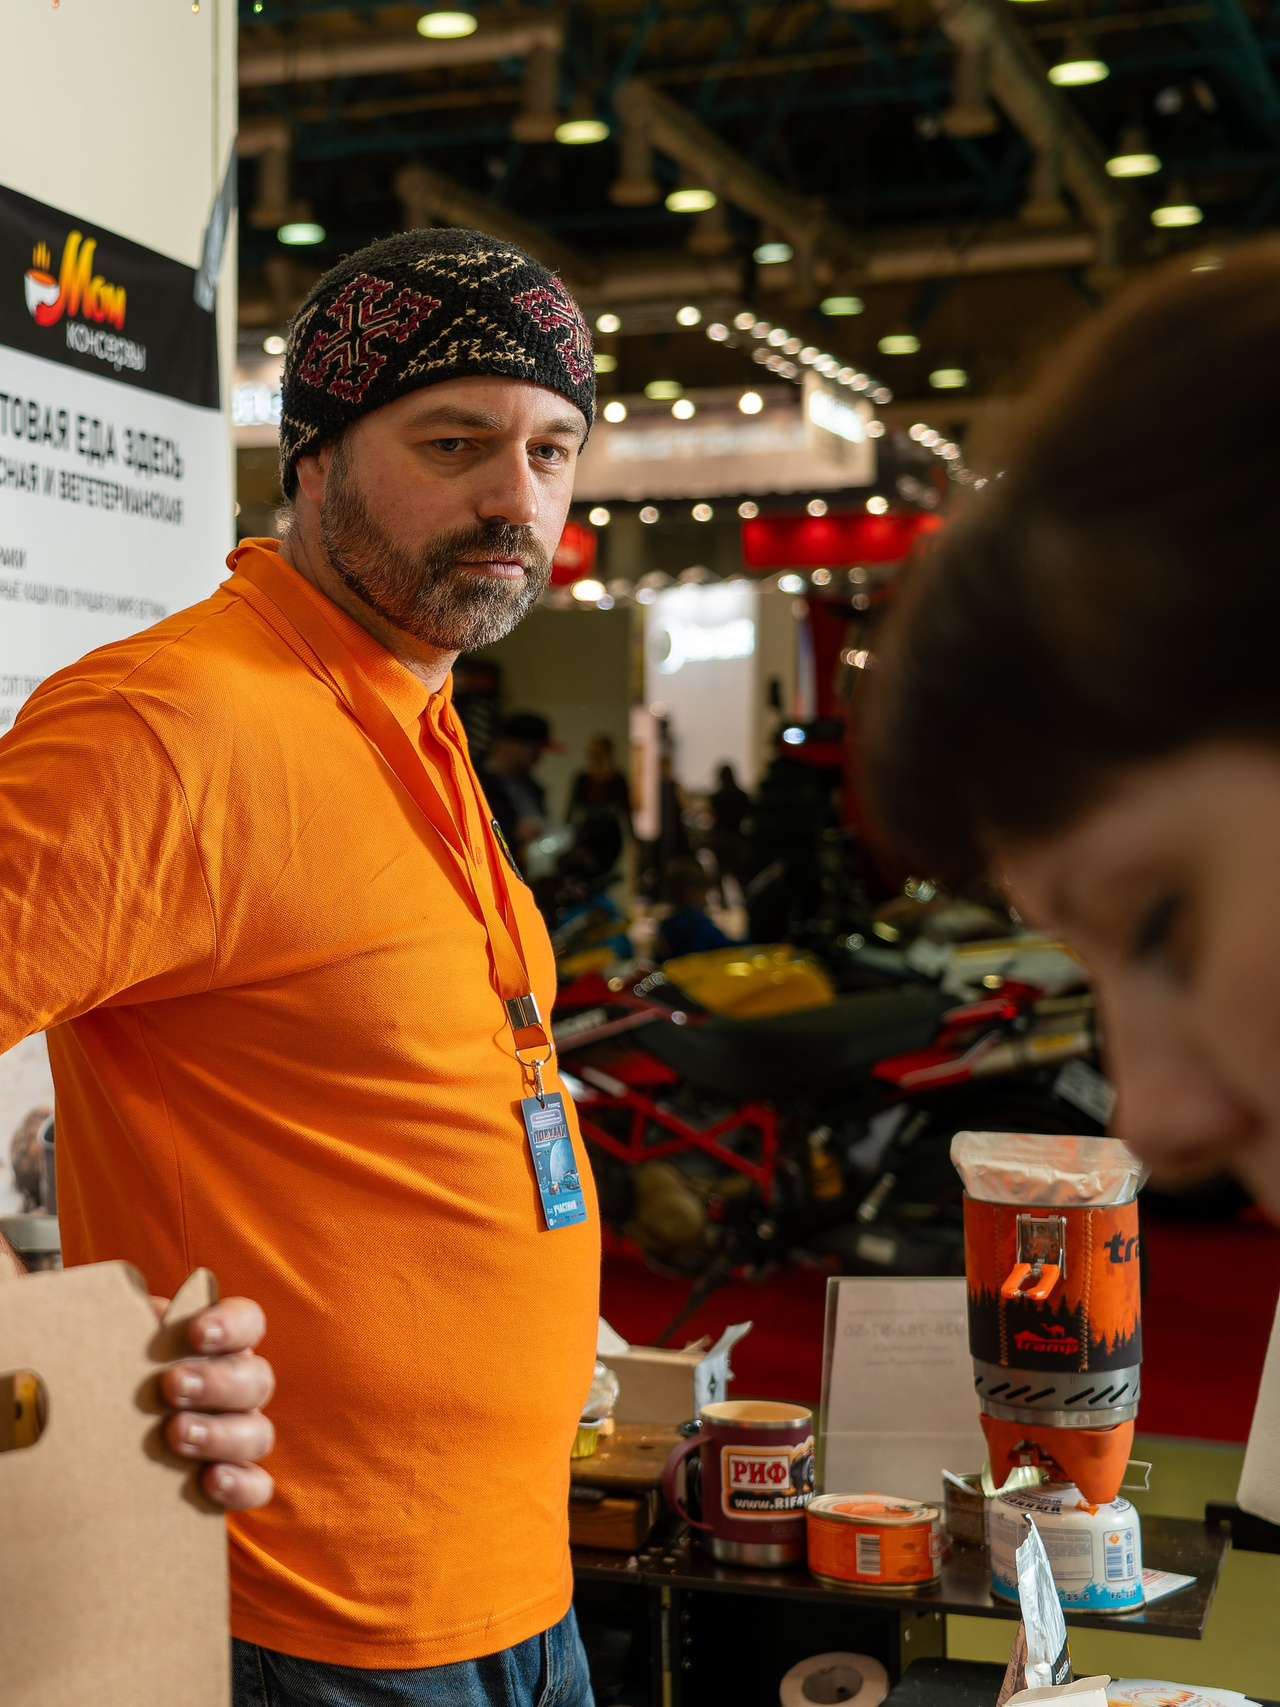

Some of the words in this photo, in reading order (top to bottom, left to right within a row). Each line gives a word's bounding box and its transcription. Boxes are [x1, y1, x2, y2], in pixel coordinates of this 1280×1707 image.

[76, 413, 118, 467] ЕДА
[123, 427, 183, 480] ЗДЕСЬ
[42, 466, 56, 497] И
[1015, 1339, 1079, 1356] tramp
[732, 1460, 787, 1484] РИФ
